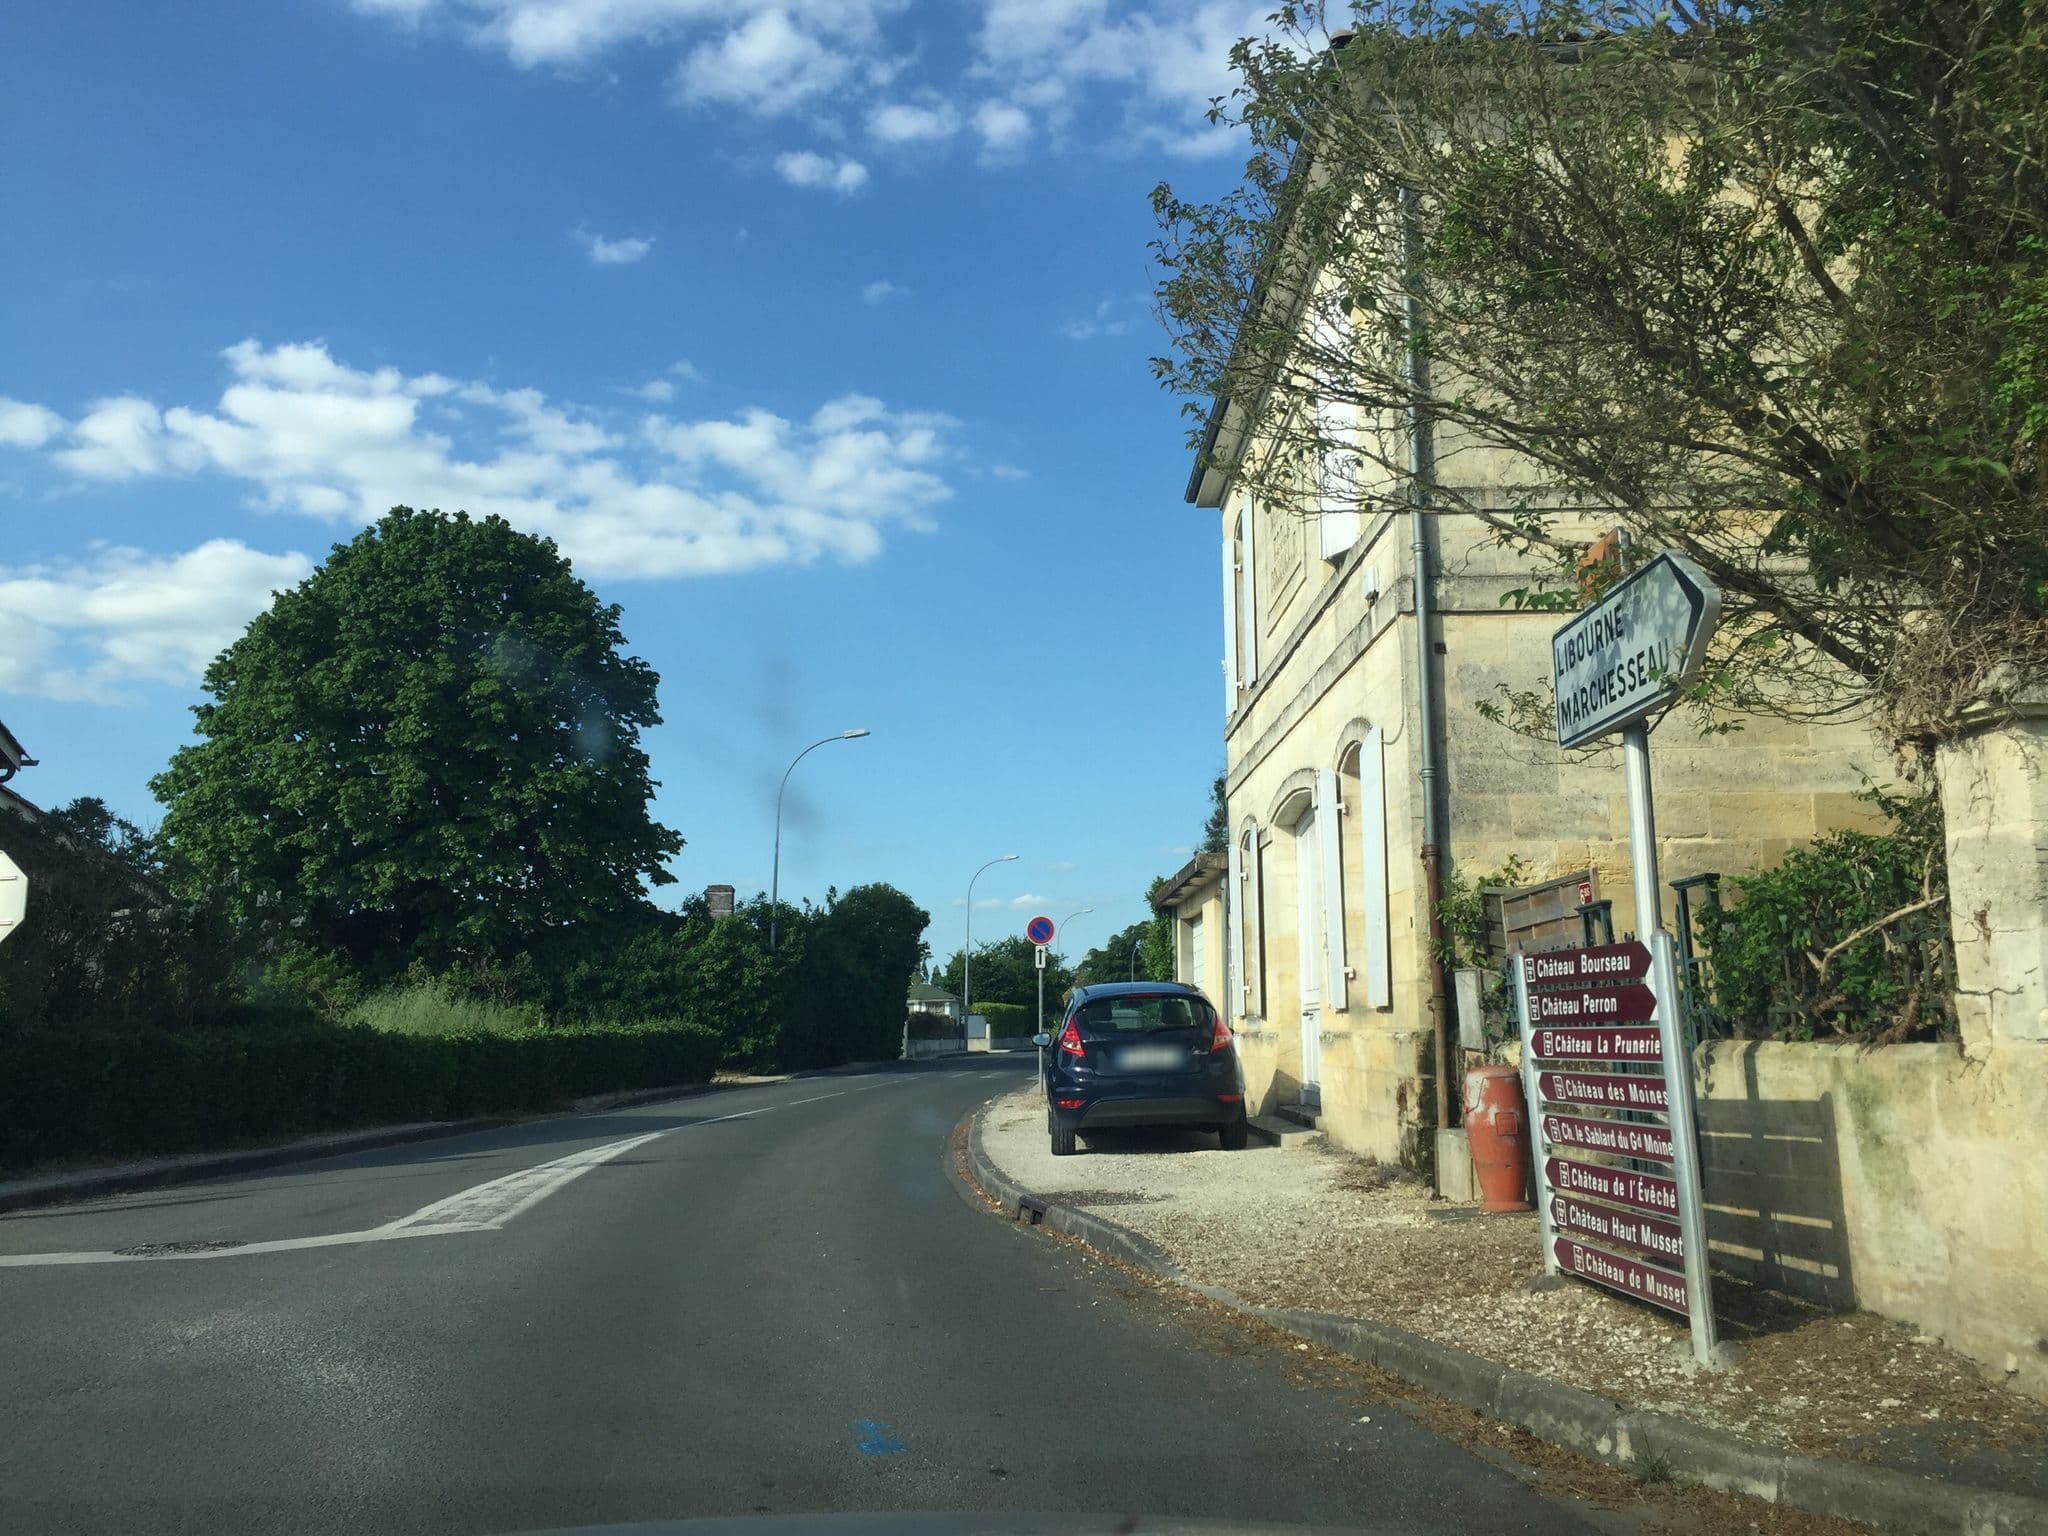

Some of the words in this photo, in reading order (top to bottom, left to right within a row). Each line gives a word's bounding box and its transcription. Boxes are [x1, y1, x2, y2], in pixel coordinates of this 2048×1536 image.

[1557, 603, 1623, 677] LIBOURNE
[1561, 638, 1669, 730] MARCHESSEAU
[1537, 959, 1574, 978] Château
[1581, 954, 1630, 973] Bourseau
[1542, 997, 1579, 1016] Château
[1583, 994, 1617, 1013] Perron
[1555, 1035, 1592, 1053] Château
[1598, 1035, 1608, 1054] La
[1615, 1034, 1660, 1054] Prunerie
[1566, 1080, 1604, 1100] Château
[1607, 1082, 1624, 1102] des
[1628, 1084, 1669, 1106] Moines
[1576, 1124, 1584, 1142] le
[1584, 1126, 1616, 1148] Sablard
[1618, 1131, 1629, 1150] du
[1572, 1168, 1608, 1193] Château
[1613, 1177, 1624, 1196] de
[1630, 1176, 1676, 1208] l'Évêché
[1570, 1205, 1608, 1234] Château
[1612, 1217, 1637, 1242] Haut
[1641, 1225, 1683, 1256] Musset
[1586, 1254, 1624, 1284] Château
[1630, 1269, 1641, 1288] de
[1646, 1274, 1686, 1306] Musset
